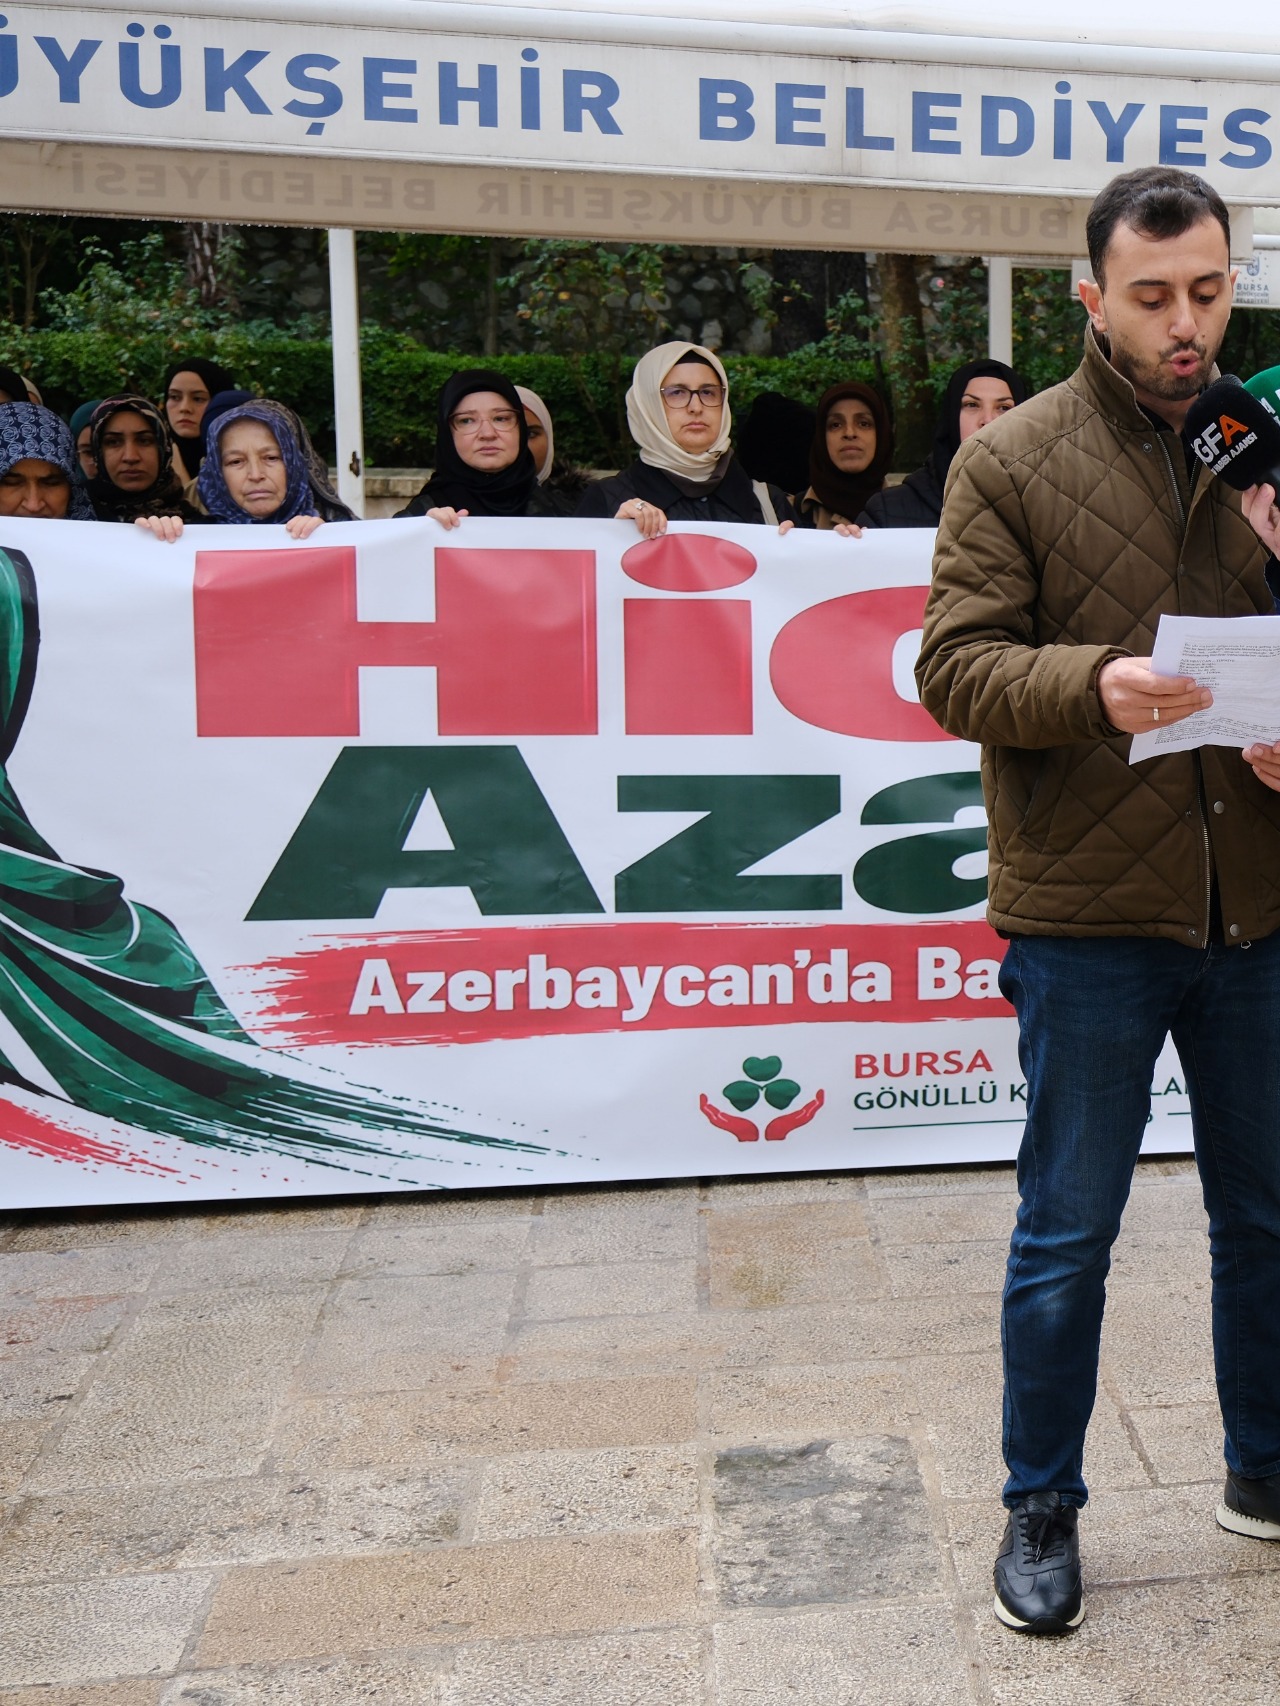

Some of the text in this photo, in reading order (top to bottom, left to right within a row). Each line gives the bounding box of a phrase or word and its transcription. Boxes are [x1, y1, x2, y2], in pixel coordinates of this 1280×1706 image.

[0, 14, 624, 136] YÜKŞEHİR
[1190, 414, 1250, 466] GFA
[854, 1049, 994, 1079] BURSA
[853, 1080, 998, 1111] GÖNÜLLÜ
